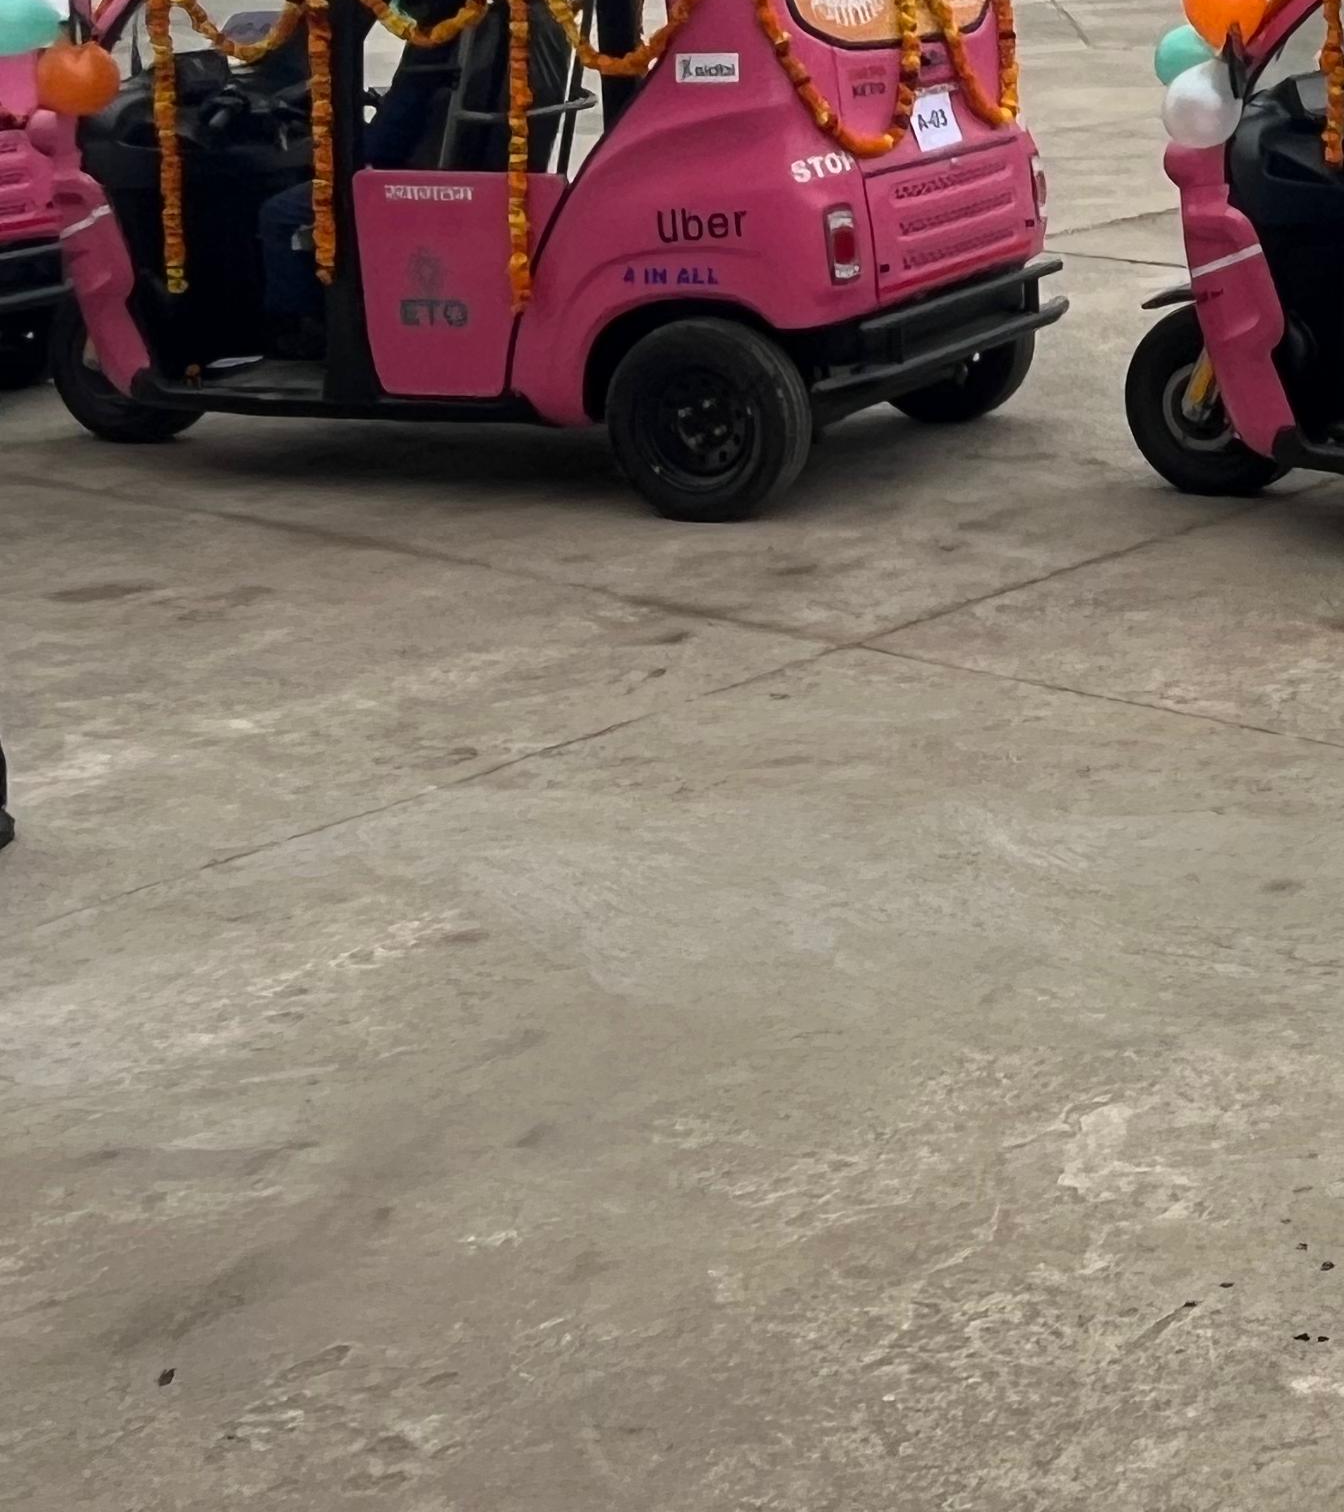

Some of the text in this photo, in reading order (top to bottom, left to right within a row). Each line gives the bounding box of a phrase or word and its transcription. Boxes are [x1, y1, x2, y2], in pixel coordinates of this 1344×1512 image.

[917, 108, 948, 132] A-03
[657, 208, 747, 243] Uber
[624, 267, 719, 285] 4 IN ALL
